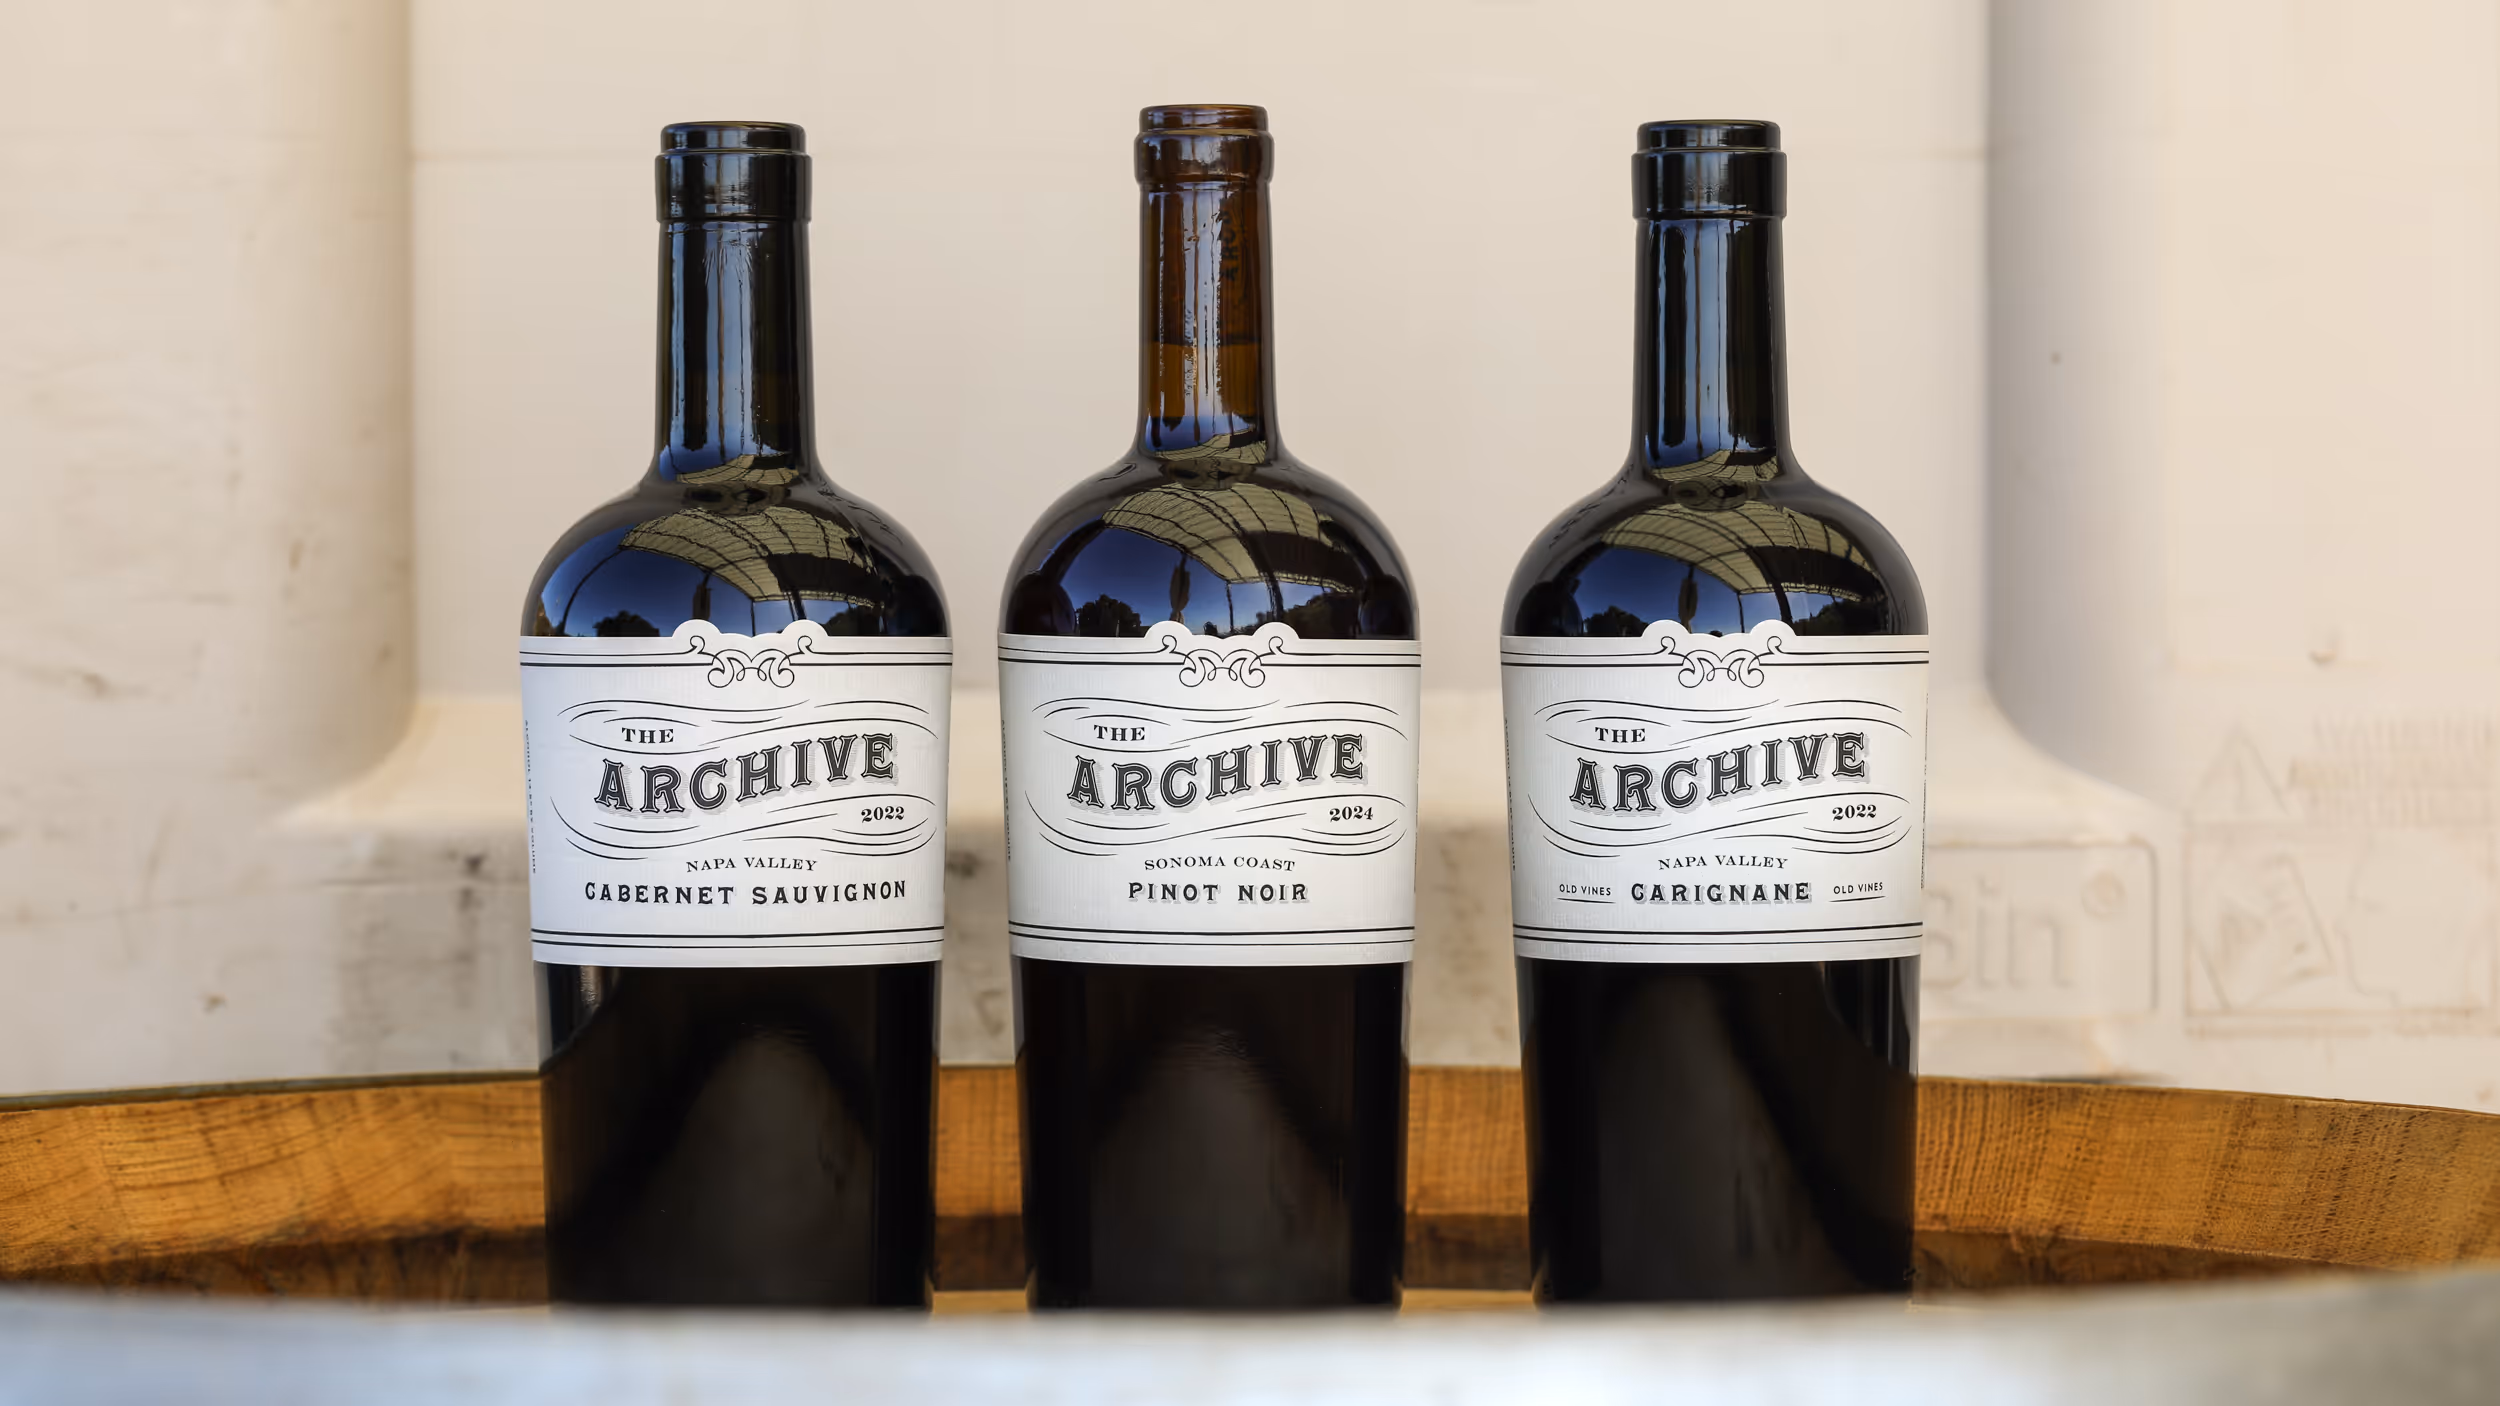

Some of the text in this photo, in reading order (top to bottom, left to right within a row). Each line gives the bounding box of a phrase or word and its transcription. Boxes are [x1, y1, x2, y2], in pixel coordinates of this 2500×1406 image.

[622, 727, 673, 744] THE
[1094, 725, 1145, 741] THE
[1595, 727, 1645, 743] THE
[594, 732, 896, 814] ARCHIVE
[1066, 733, 1366, 811] ARCHIVE
[1568, 732, 1867, 812] ARCHIVE
[861, 806, 904, 823] 2022
[1330, 806, 1373, 822] 2024
[1832, 804, 1876, 821] 2022
[685, 857, 817, 872] NAPA VALLEY
[1145, 856, 1296, 871] SONOMA COAST
[1658, 855, 1788, 870] NAPA VALLEY
[584, 881, 905, 905] CABERNET SAUVIGNON
[1129, 882, 1307, 902] PINOT NOIR
[1558, 883, 1612, 897] OLD VINES
[1631, 882, 1811, 903] CARIGNANE
[1833, 882, 1883, 895] OLD VINES
